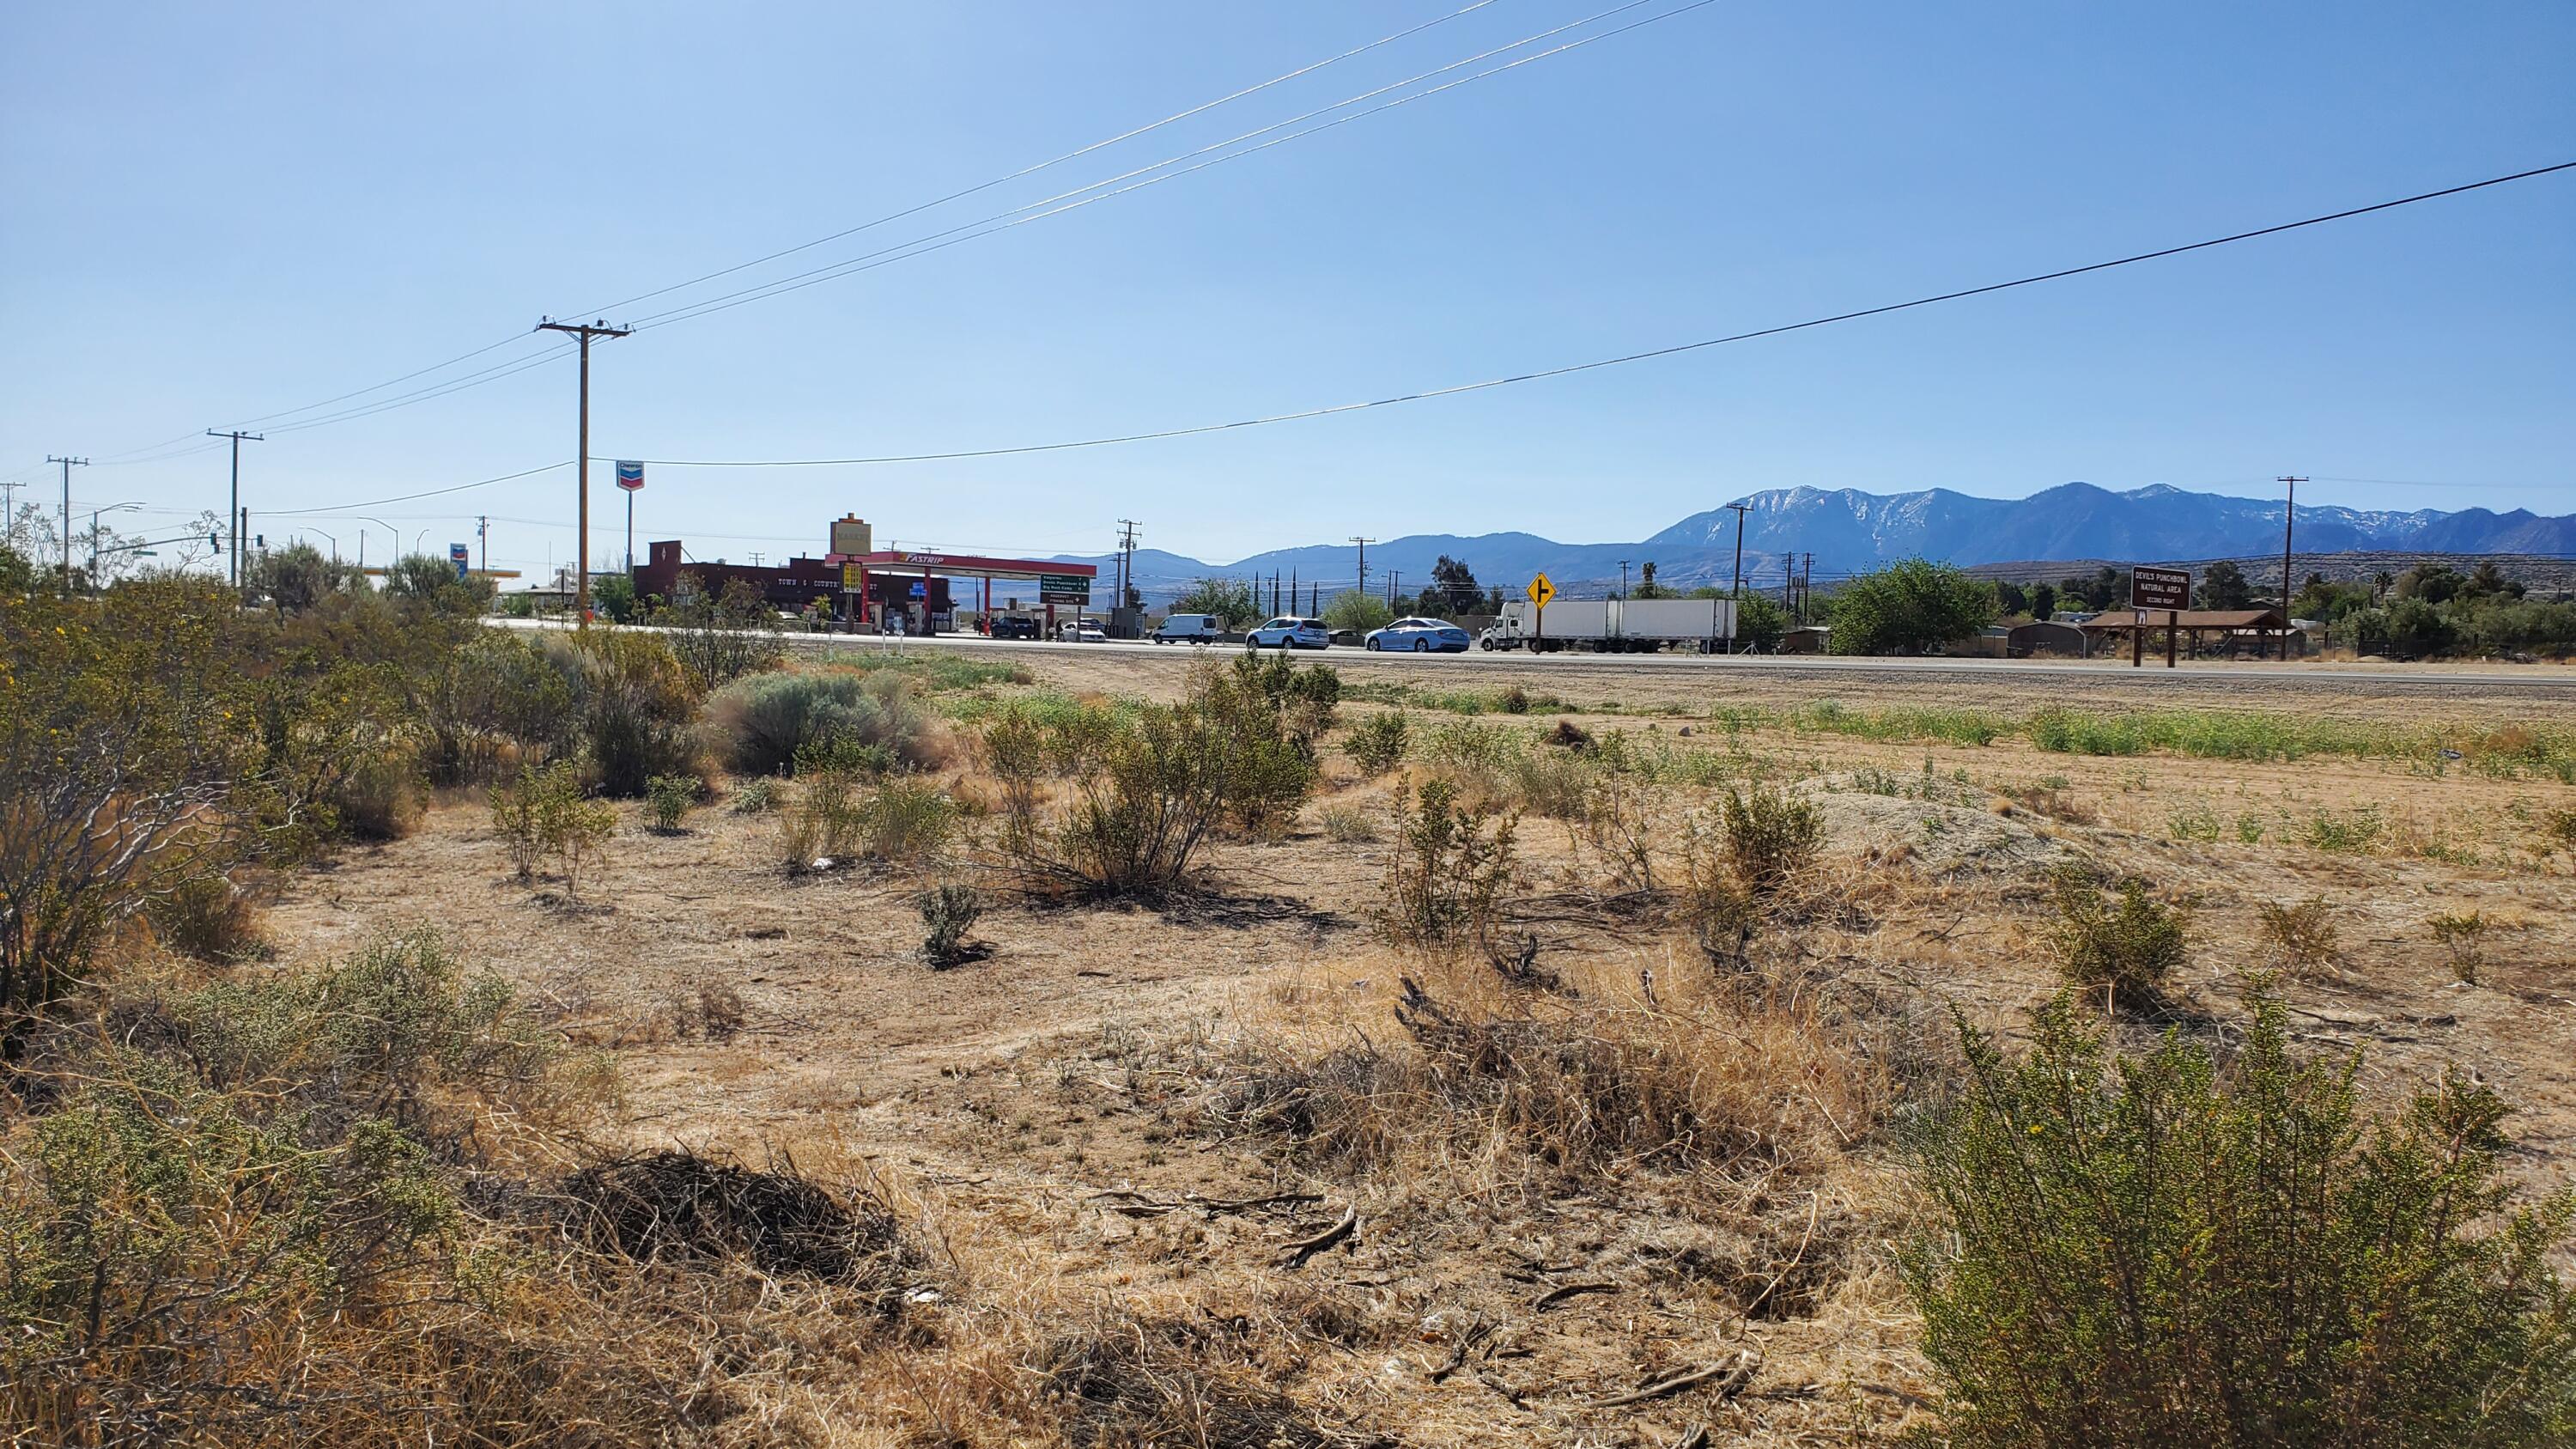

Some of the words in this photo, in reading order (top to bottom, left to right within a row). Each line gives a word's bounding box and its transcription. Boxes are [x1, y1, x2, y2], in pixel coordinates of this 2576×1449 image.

[905, 553, 945, 564] FASTRIP
[2156, 574, 2188, 583] PUNCHBOWL
[2141, 583, 2165, 592] NATURAL
[2167, 585, 2182, 594] AREA
